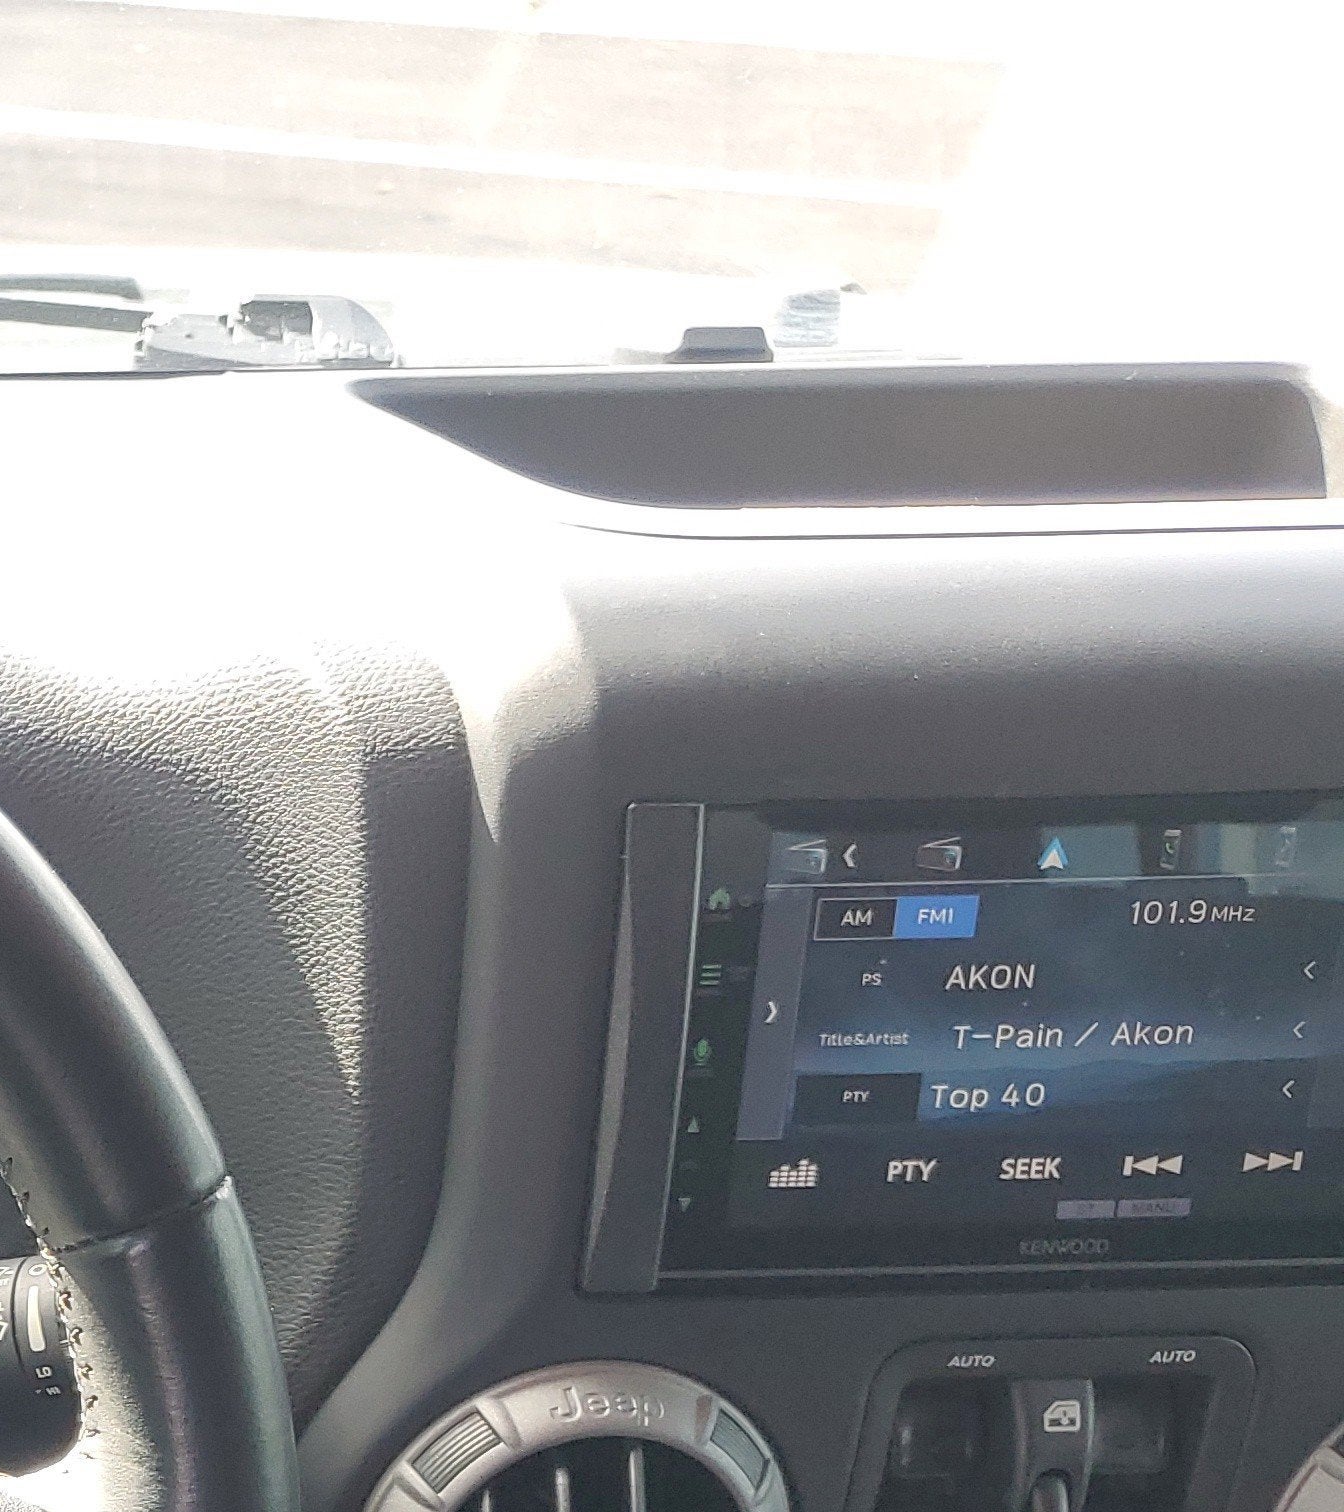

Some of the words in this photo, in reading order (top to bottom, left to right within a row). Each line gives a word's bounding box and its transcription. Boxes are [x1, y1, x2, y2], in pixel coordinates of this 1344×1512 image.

[840, 910, 873, 927] AM
[1129, 900, 1209, 926] 101.9
[1210, 906, 1258, 923] MHz
[862, 973, 883, 987] PS
[944, 964, 1037, 991] AKON
[953, 1024, 1064, 1050] T-Pain
[1111, 1021, 1195, 1046] Akon
[930, 1084, 990, 1112] Top
[999, 1083, 1046, 1108] 40
[886, 1158, 939, 1183] PTY
[999, 1156, 1062, 1181] SEEK
[947, 1354, 996, 1369] AUTO
[1149, 1349, 1196, 1364] AUTO
[549, 1385, 665, 1427] Jeep
